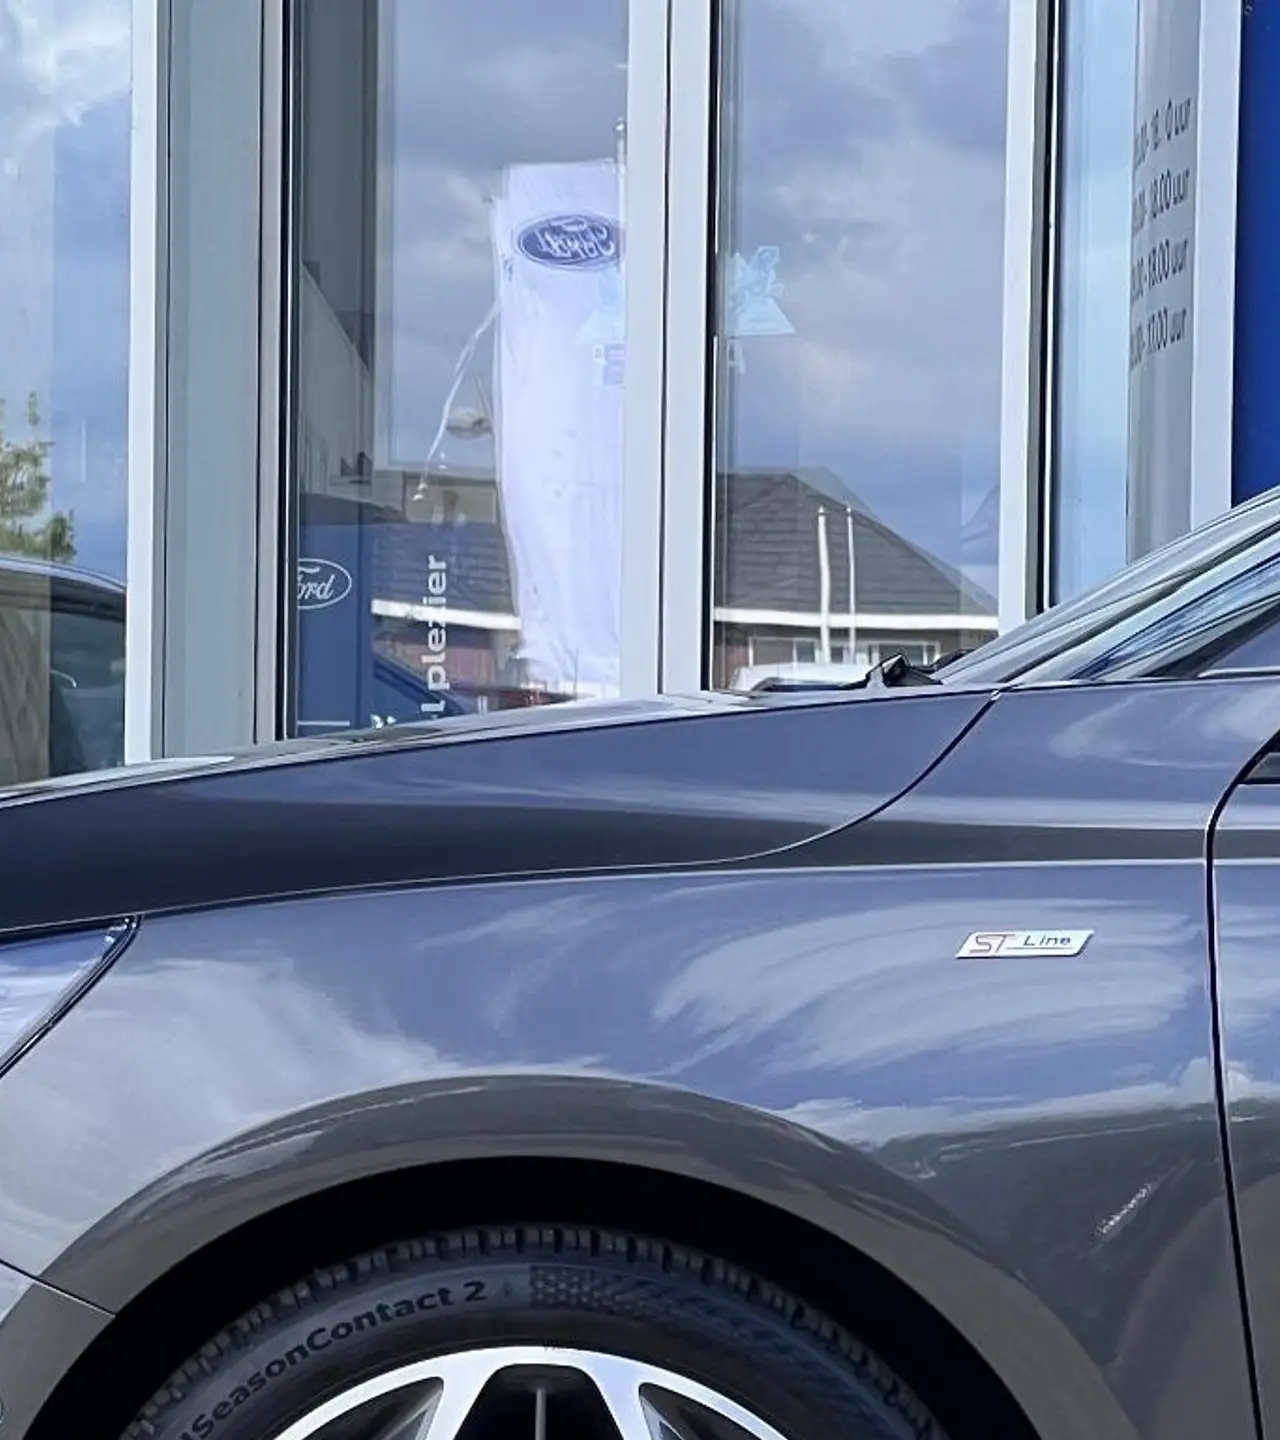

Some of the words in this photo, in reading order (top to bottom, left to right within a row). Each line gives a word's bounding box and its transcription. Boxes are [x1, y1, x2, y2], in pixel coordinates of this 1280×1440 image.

[969, 933, 1016, 954] ST
[1023, 934, 1072, 947] Line
[463, 1280, 488, 1302] 2
